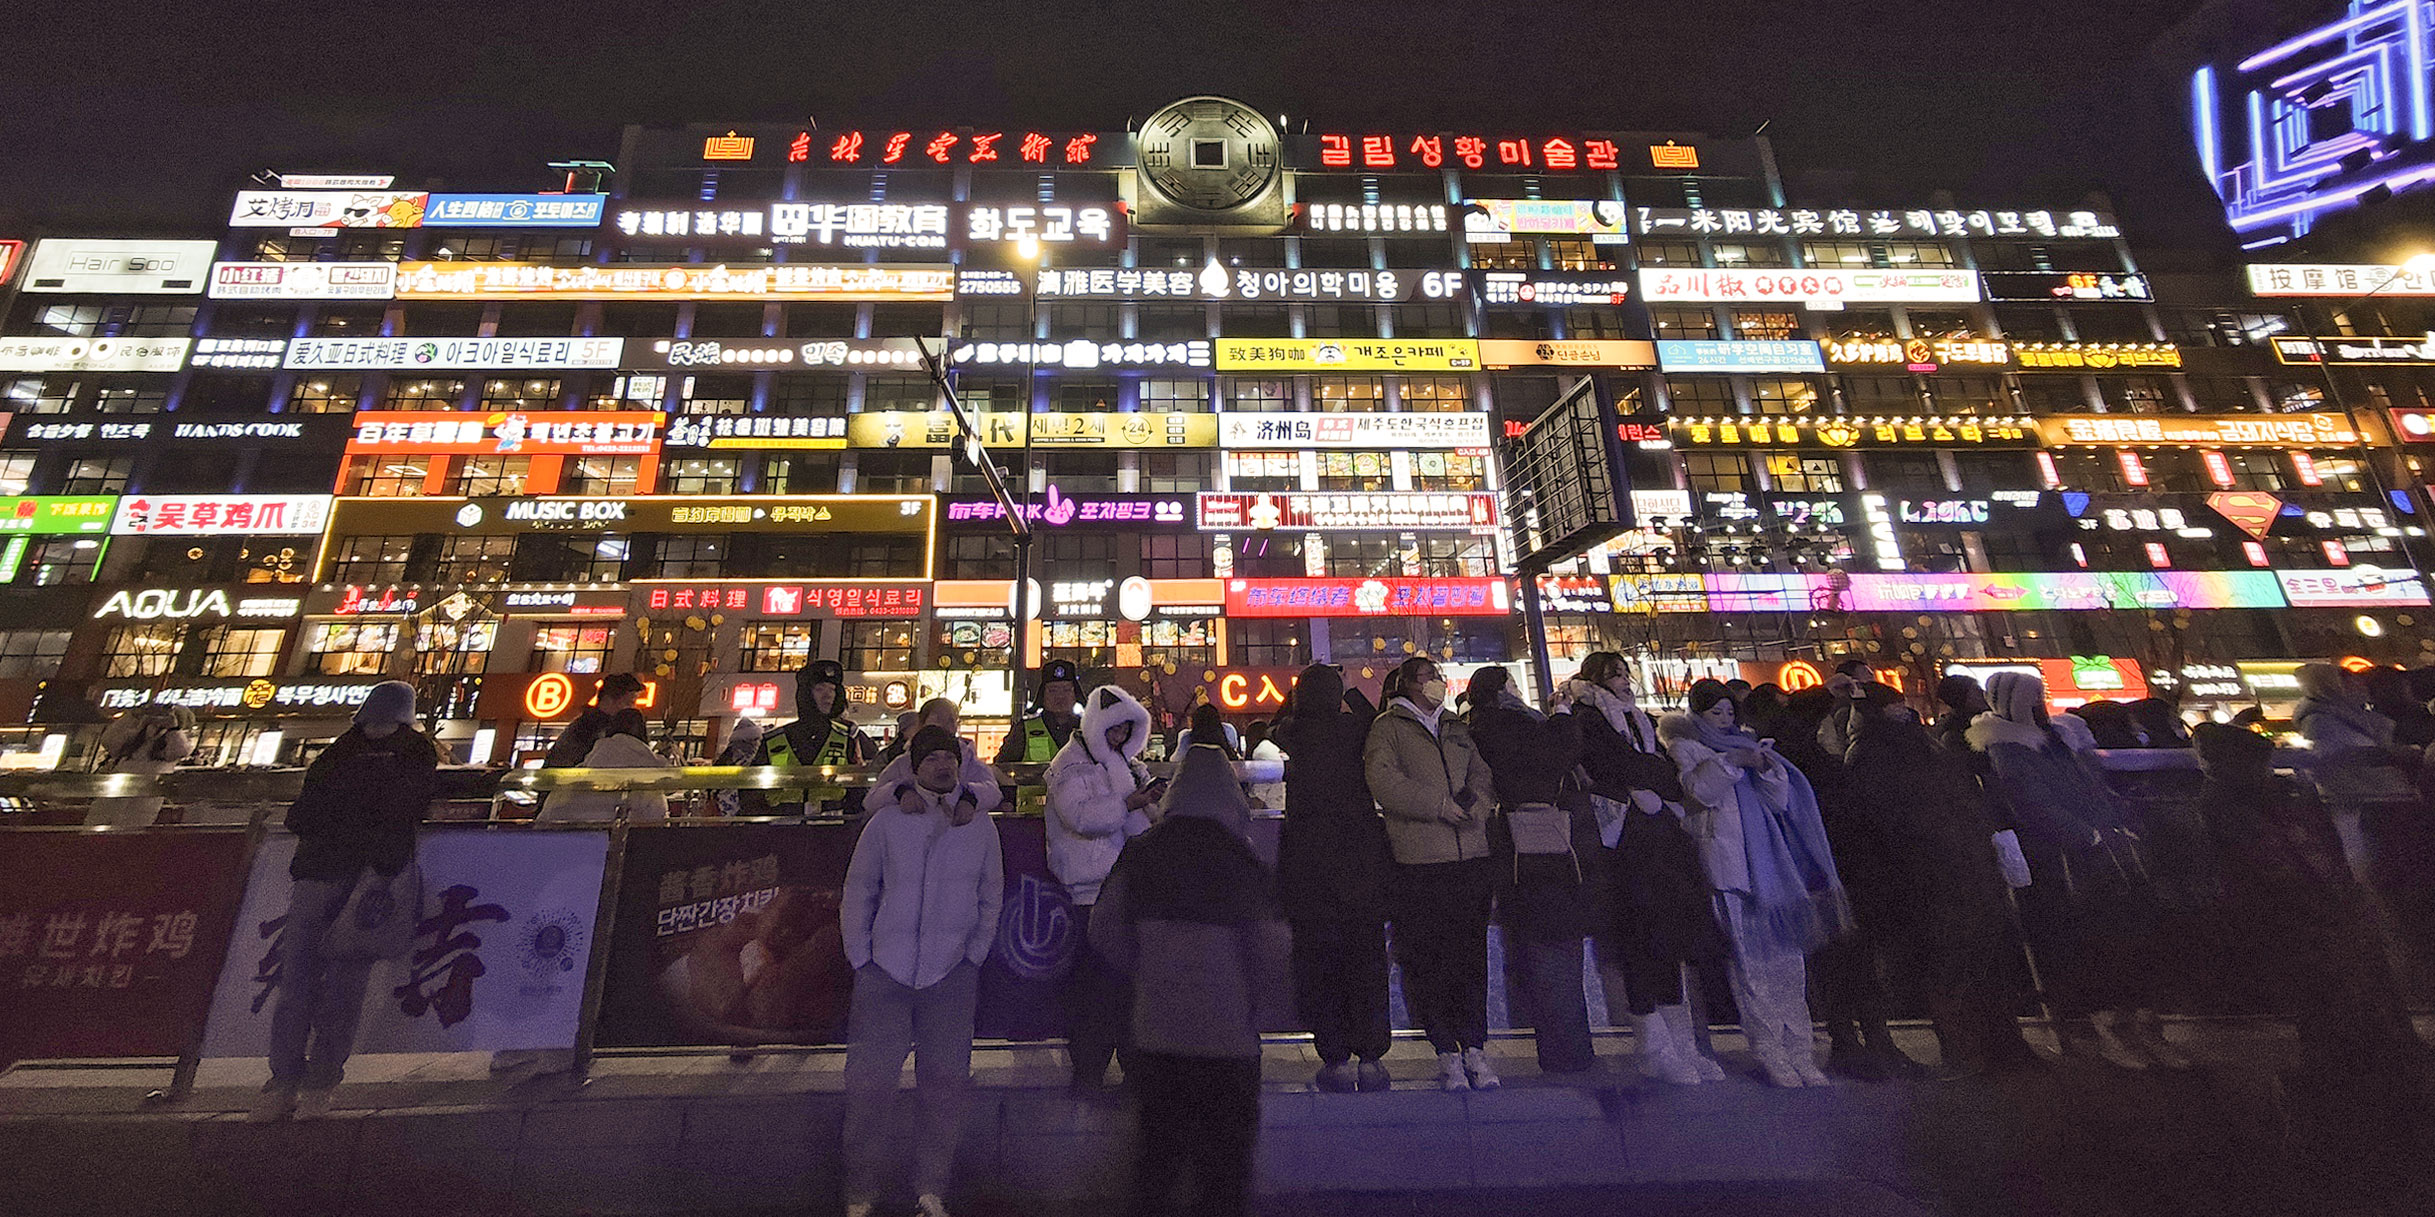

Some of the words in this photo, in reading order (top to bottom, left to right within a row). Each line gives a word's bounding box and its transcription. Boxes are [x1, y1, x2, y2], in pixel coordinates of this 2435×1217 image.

[1320, 134, 1619, 169] 길림성황미술관
[968, 207, 1111, 242] 화도교육
[1655, 209, 1861, 235] 一米阳光宾馆
[1237, 269, 1398, 299] 청아의학미용
[1422, 272, 1463, 298] 6F
[2270, 268, 2359, 291] 按摩馆
[446, 341, 570, 365] 아크아일식료리
[581, 341, 610, 358] 5F
[1256, 420, 1312, 441] 济州岛
[1875, 424, 1983, 444] 러브스타
[153, 502, 288, 529] 吴草鸡爪
[505, 501, 575, 520] MUSIC
[579, 501, 627, 520] BOX
[900, 501, 922, 516] 3F
[1078, 501, 1152, 520] 포차핑크
[94, 588, 232, 619] AQUA
[650, 588, 748, 609] 日式料理
[806, 588, 923, 608] 식영일식료리
